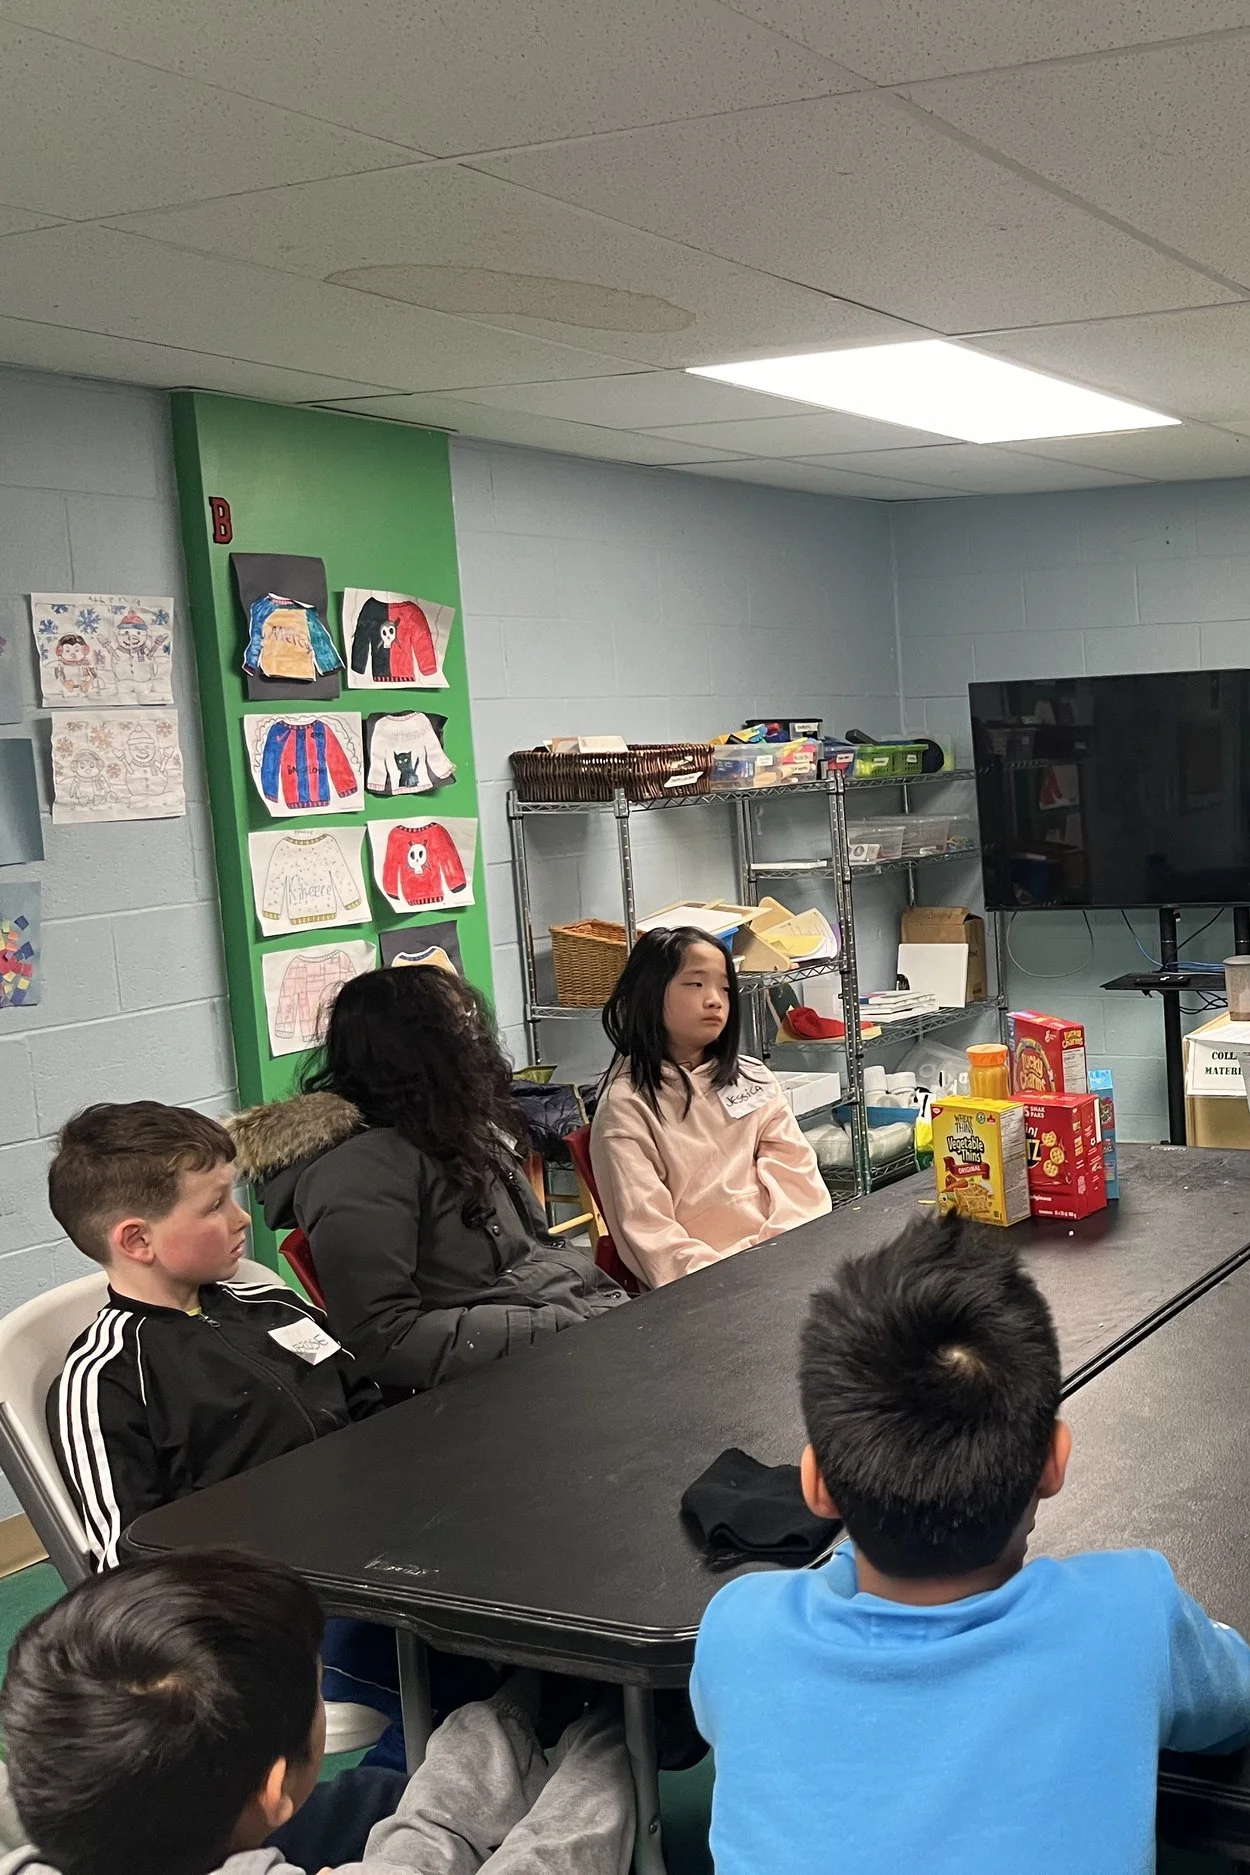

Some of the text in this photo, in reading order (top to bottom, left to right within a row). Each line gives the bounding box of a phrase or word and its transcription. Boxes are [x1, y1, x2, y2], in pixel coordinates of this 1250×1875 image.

[208, 496, 233, 545] B
[1211, 1051, 1239, 1060] COLL
[1204, 1066, 1242, 1076] MATERI
[946, 1134, 985, 1153] Vegetable
[960, 1149, 983, 1165] Thins
